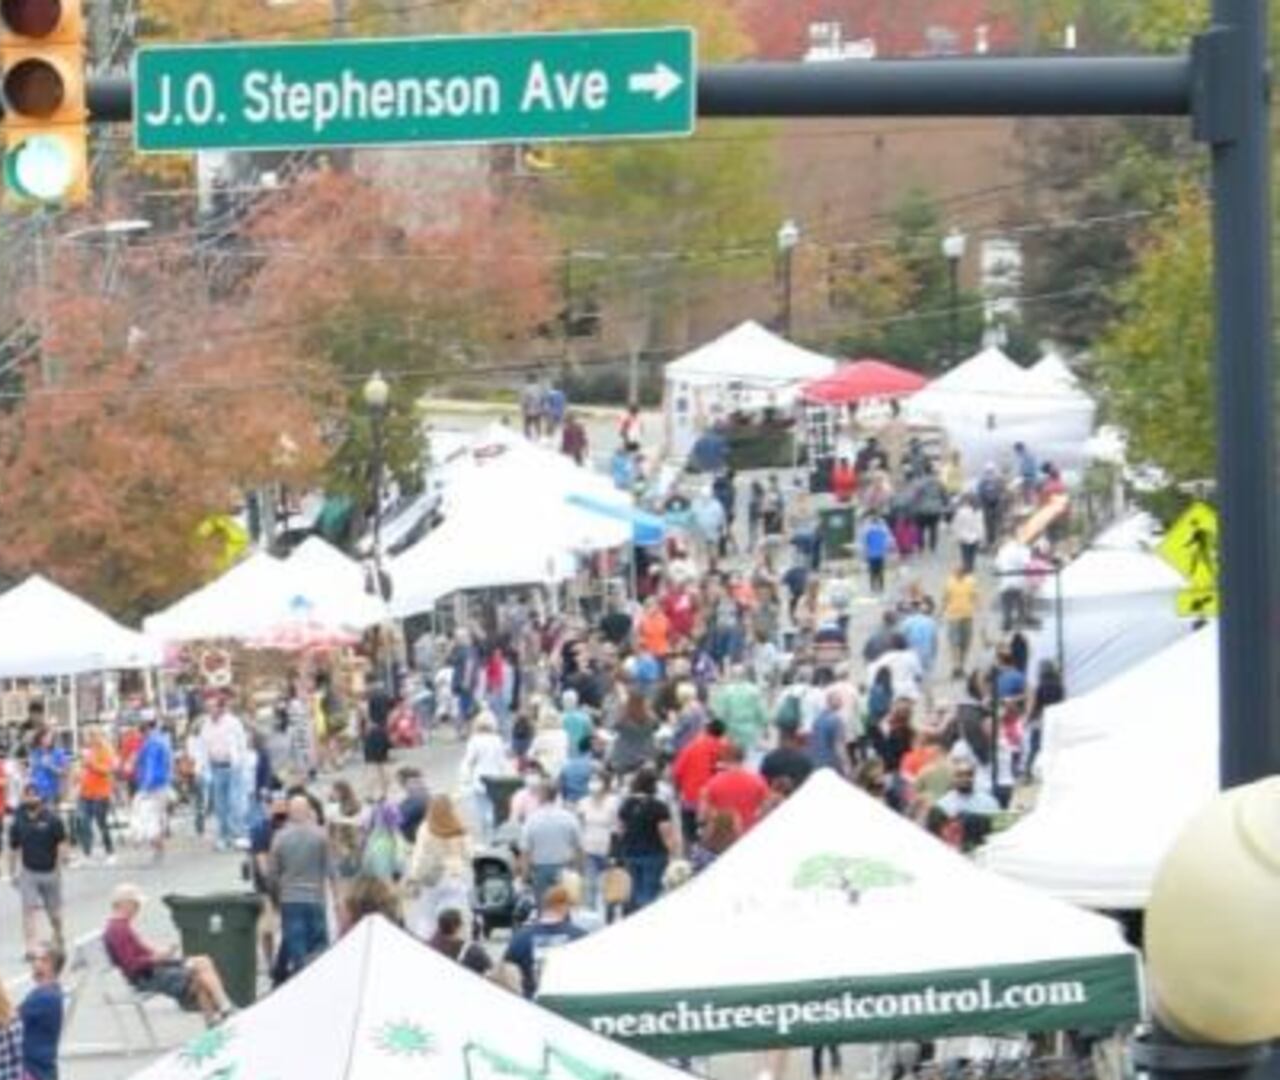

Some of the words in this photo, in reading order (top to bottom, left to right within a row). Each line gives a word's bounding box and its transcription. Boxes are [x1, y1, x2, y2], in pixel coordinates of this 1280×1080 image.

[144, 72, 225, 127] J.O.
[243, 69, 501, 132] Stephenson
[521, 61, 610, 111] Ave
[589, 977, 1087, 1038] peachtreepestcontrol.com
